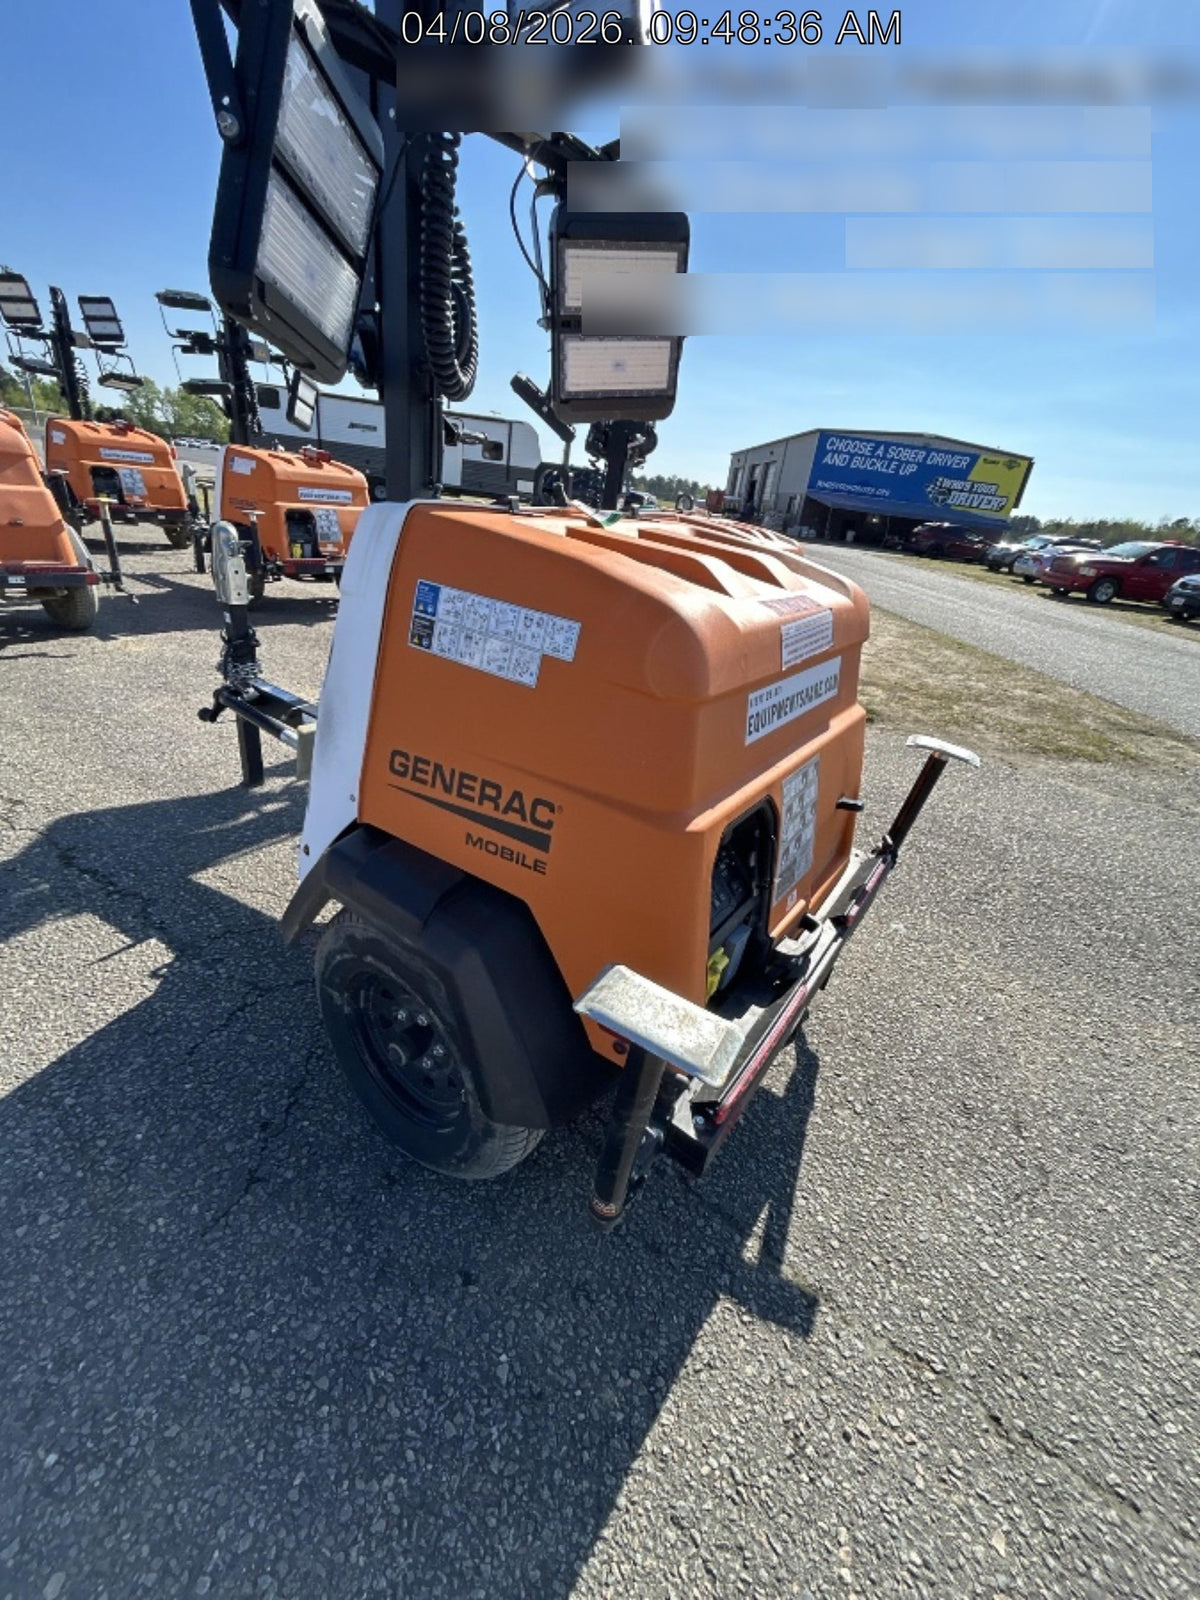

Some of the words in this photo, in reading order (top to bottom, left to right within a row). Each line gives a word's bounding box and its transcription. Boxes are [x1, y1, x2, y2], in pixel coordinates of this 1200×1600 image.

[822, 452, 849, 467] AND
[850, 457, 896, 474] BUCKLE
[899, 463, 918, 476] UP
[825, 436, 875, 456] CHOOSE
[874, 445, 884, 457] A
[887, 446, 924, 463] SOBER
[926, 452, 970, 469] DRIVER
[947, 490, 1008, 512] DRIVER?
[972, 482, 998, 495] YOUR
[388, 749, 556, 831] GENERAC
[465, 832, 548, 876] MOBILE
